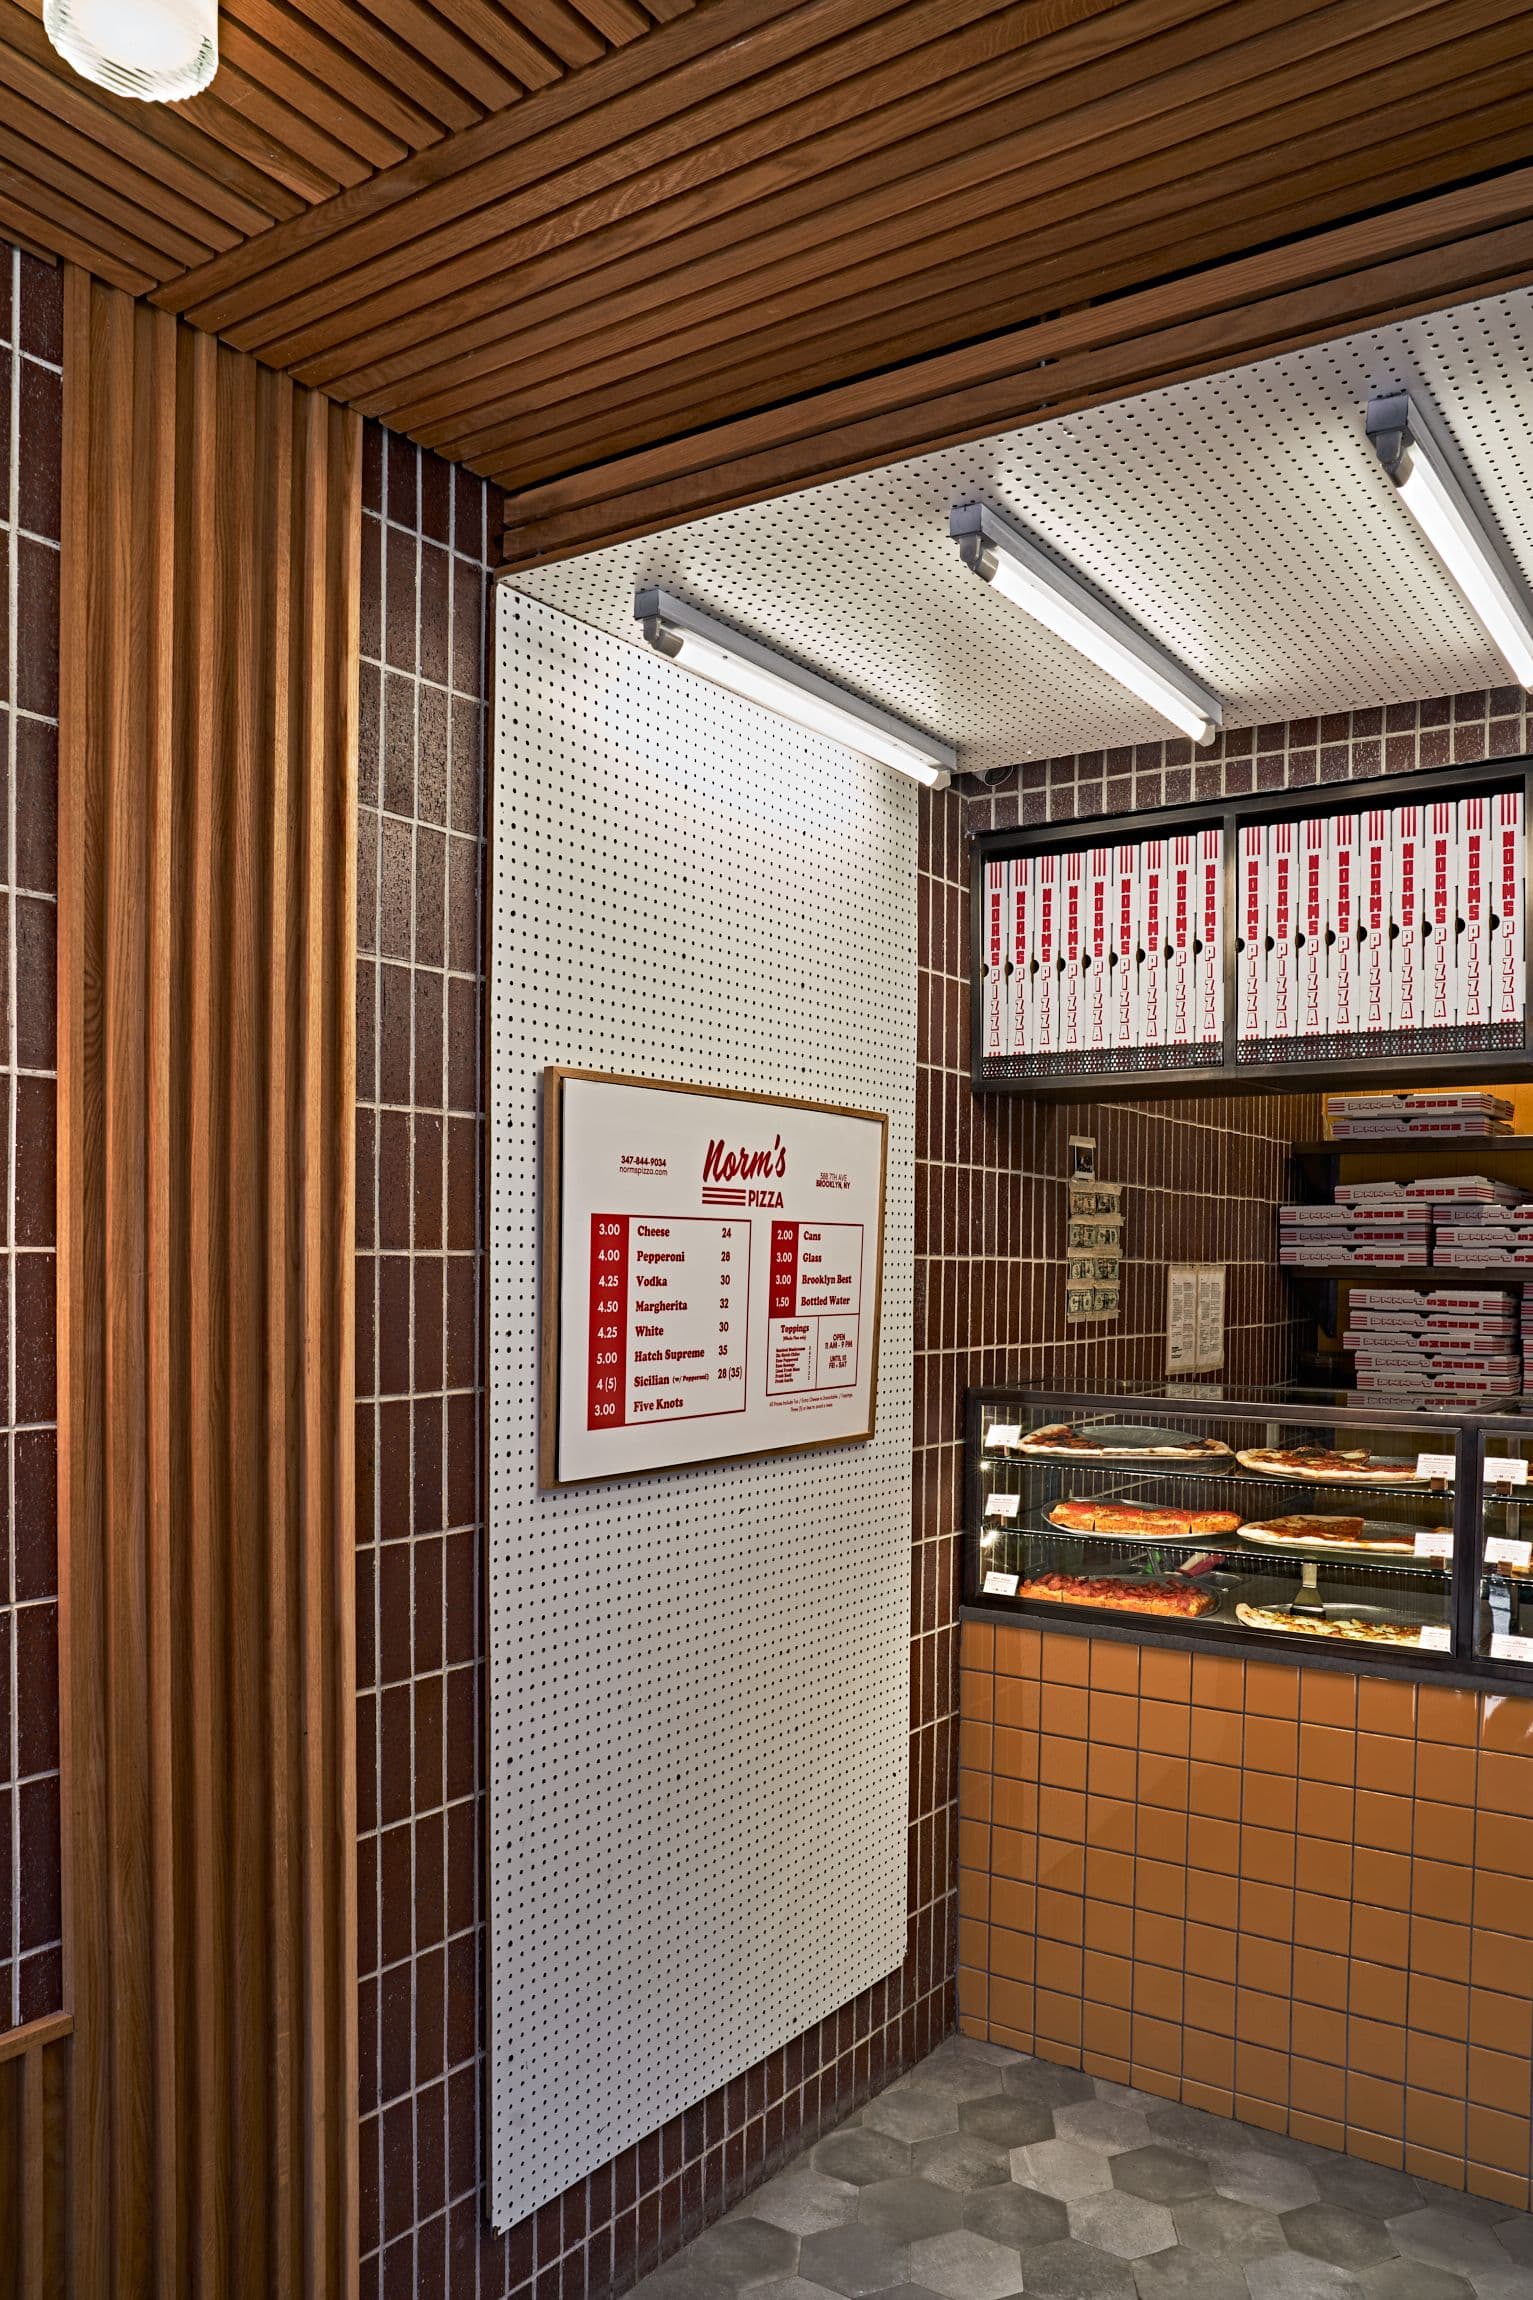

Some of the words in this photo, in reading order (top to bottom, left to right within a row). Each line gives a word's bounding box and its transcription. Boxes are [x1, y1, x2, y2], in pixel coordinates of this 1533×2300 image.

[1176, 870, 1186, 947] NORMS
[1205, 865, 1216, 942] NORMS
[1247, 861, 1258, 940] NORMS
[1277, 859, 1288, 939] NORMS
[1308, 855, 1319, 936] NORMS
[1338, 851, 1350, 933] NORMS
[1370, 846, 1381, 929] NORMS
[1401, 843, 1414, 926] NORMS
[1434, 840, 1447, 924] NORMS
[1467, 836, 1480, 920] NORMS
[1502, 831, 1515, 916] NORMS
[991, 894, 1000, 965] NORMS
[1016, 891, 1026, 964] NORMS
[1041, 888, 1051, 962] NORMS
[1068, 886, 1078, 960] NORMS
[1094, 882, 1104, 957] NORMS
[1120, 879, 1131, 955] NORMS
[1147, 875, 1158, 951] NORMS
[1041, 965, 1051, 1044] PIZZA
[1067, 963, 1078, 1043] PIZZA
[1093, 961, 1104, 1041] PIZZA
[1120, 958, 1131, 1039] PIZZA
[1147, 955, 1158, 1037] PIZZA
[1175, 950, 1186, 1033] PIZZA
[1204, 946, 1216, 1029] PIZZA
[1247, 944, 1258, 1028] PIZZA
[1276, 943, 1288, 1028] PIZZA
[1307, 939, 1319, 1025] PIZZA
[1338, 936, 1350, 1023] PIZZA
[1369, 932, 1381, 1020] PIZZA
[1401, 929, 1414, 1018] PIZZA
[1434, 927, 1447, 1017] PIZZA
[1467, 924, 1480, 1015] PIZZA
[1501, 921, 1515, 1012] PIZZA
[990, 969, 1000, 1046] PIZZA
[1016, 967, 1026, 1045] PIZZA
[620, 1166, 668, 1176] normspizza.com
[621, 1156, 666, 1167] 347-844-9034
[702, 1134, 786, 1182] Norm's
[599, 1224, 620, 1235] 3.00
[638, 1226, 670, 1237] Cheese
[722, 1228, 731, 1238] 24
[748, 1190, 784, 1208] PIZZA
[778, 1230, 793, 1240] 2.00
[804, 1231, 821, 1240] Cans
[599, 1250, 619, 1261] 4.00
[637, 1251, 684, 1264] Pepperoni
[721, 1251, 730, 1262] 28
[599, 1275, 618, 1287] 4.25
[637, 1276, 667, 1286] Vodka
[721, 1275, 730, 1285] 30
[776, 1252, 792, 1262] 3.00
[803, 1253, 821, 1262] Glass
[776, 1275, 791, 1284] 3.00
[802, 1275, 835, 1286] Brooklyn
[837, 1275, 852, 1284] Best
[597, 1301, 618, 1312] 4.50
[636, 1300, 687, 1313] Margherita
[720, 1299, 728, 1309] 32
[598, 1327, 617, 1338] 4.25
[635, 1326, 664, 1337] White
[719, 1322, 729, 1332] 30
[776, 1297, 789, 1307] 1.50
[801, 1296, 827, 1306] Bottled
[830, 1296, 850, 1305] Water
[781, 1324, 809, 1334] Toppings
[833, 1333, 845, 1341] OPEN
[597, 1352, 617, 1364] 5.00
[634, 1351, 663, 1362] Hatch
[665, 1349, 704, 1361] Supreme
[719, 1345, 727, 1356] 35
[597, 1378, 603, 1390] 4
[605, 1377, 617, 1392] (5)
[634, 1376, 669, 1387] Sicilian
[718, 1369, 726, 1379] 28
[729, 1367, 742, 1380] (35)
[595, 1404, 615, 1416] 3.00
[633, 1401, 654, 1412] Five
[656, 1398, 683, 1410] Knots
